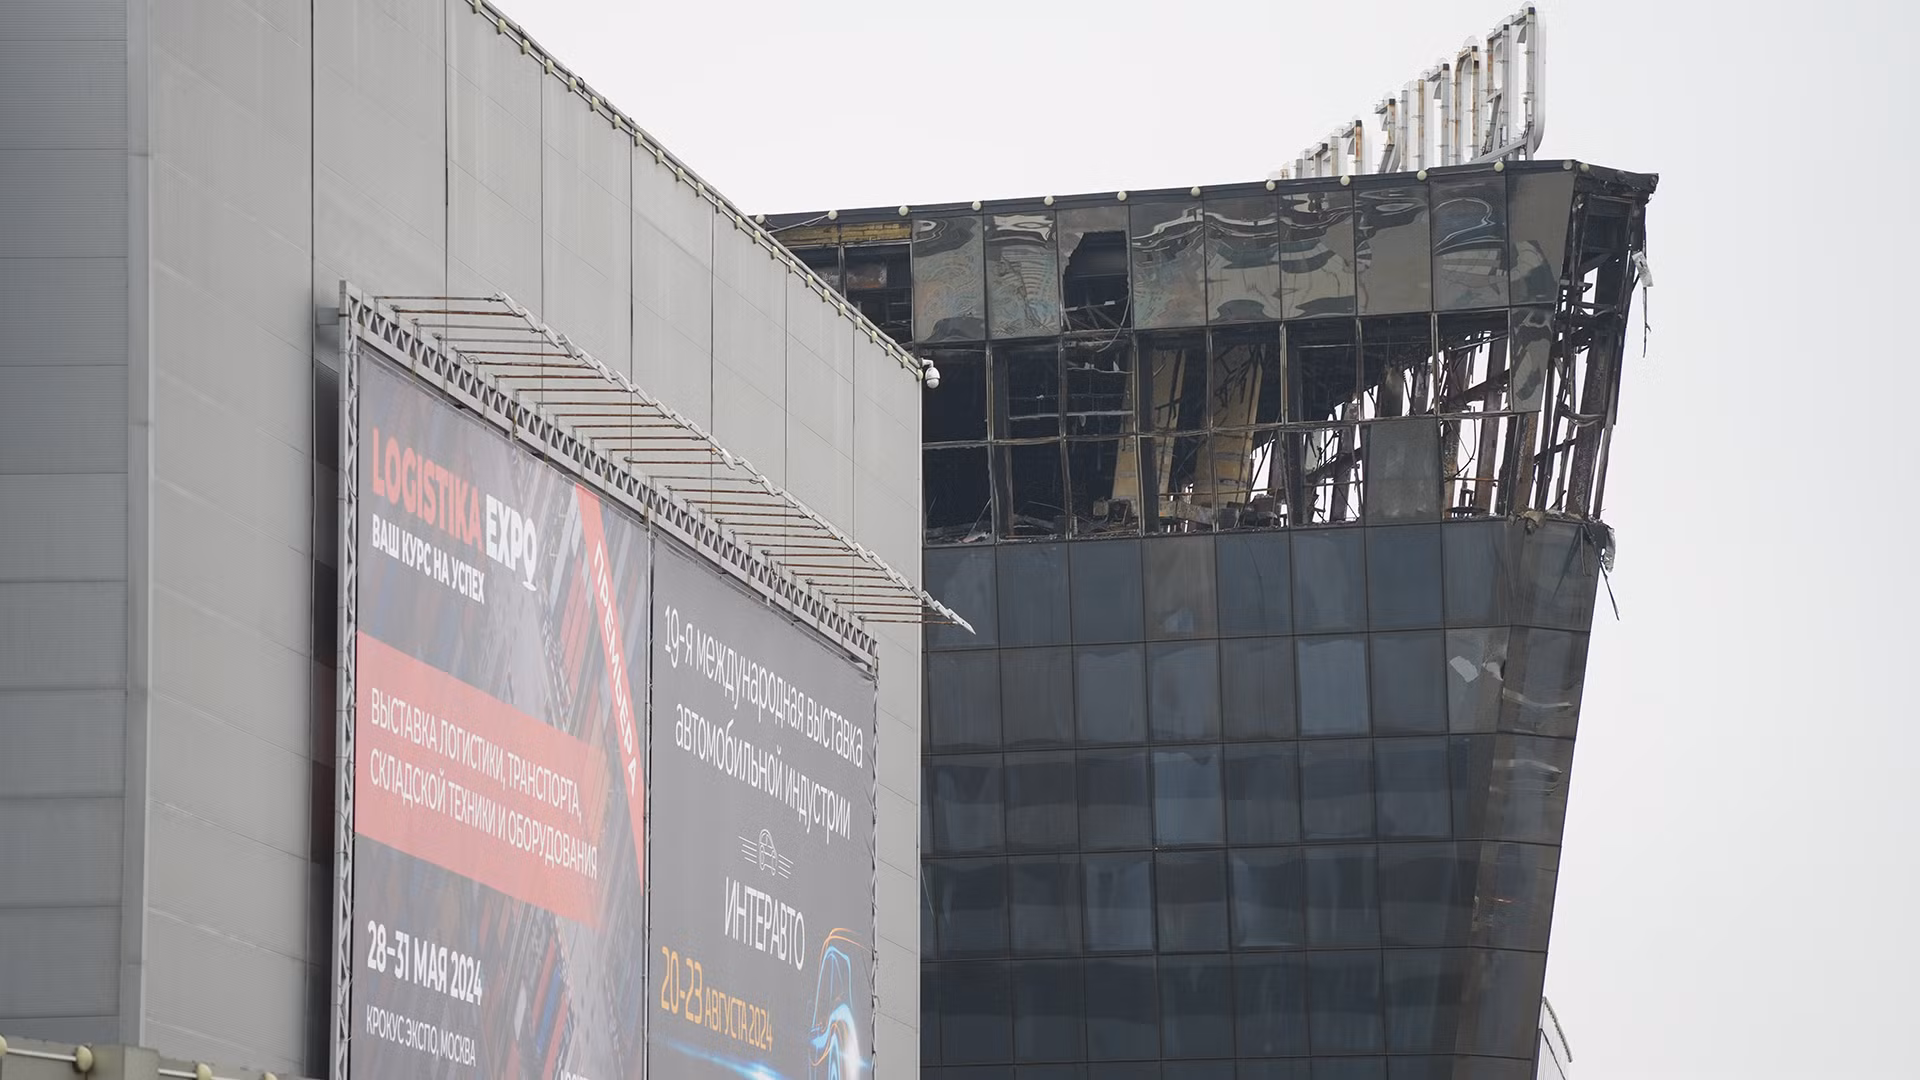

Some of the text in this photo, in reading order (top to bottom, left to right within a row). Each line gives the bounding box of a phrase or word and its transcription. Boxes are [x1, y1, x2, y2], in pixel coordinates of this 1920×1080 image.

[372, 513, 485, 604] ВАШ КУРС НА УСПЕХ
[373, 427, 537, 591] LOGISTIKA EXPO
[594, 540, 636, 796] ПРЕМЬЕРА
[664, 605, 863, 769] 19-я международная выставка
[370, 748, 598, 881] СКЛАДСКОЙ ТЕХНИКИ И ОБОРУДОВАНИЯ
[371, 687, 582, 824] ВЫСТАВКА ЛОГИСТИКИ, ТРАНСПОРТА,
[675, 703, 851, 845] автомобильной индустрии
[413, 937, 448, 993] МАЯ
[450, 951, 482, 1006] 2024
[724, 876, 805, 971] ИНТЕРАВТО
[366, 1004, 477, 1067] КРОКУС ЭКСПО, МОСКВА
[661, 946, 773, 1052] 20-23 АВГУСТА 2024
